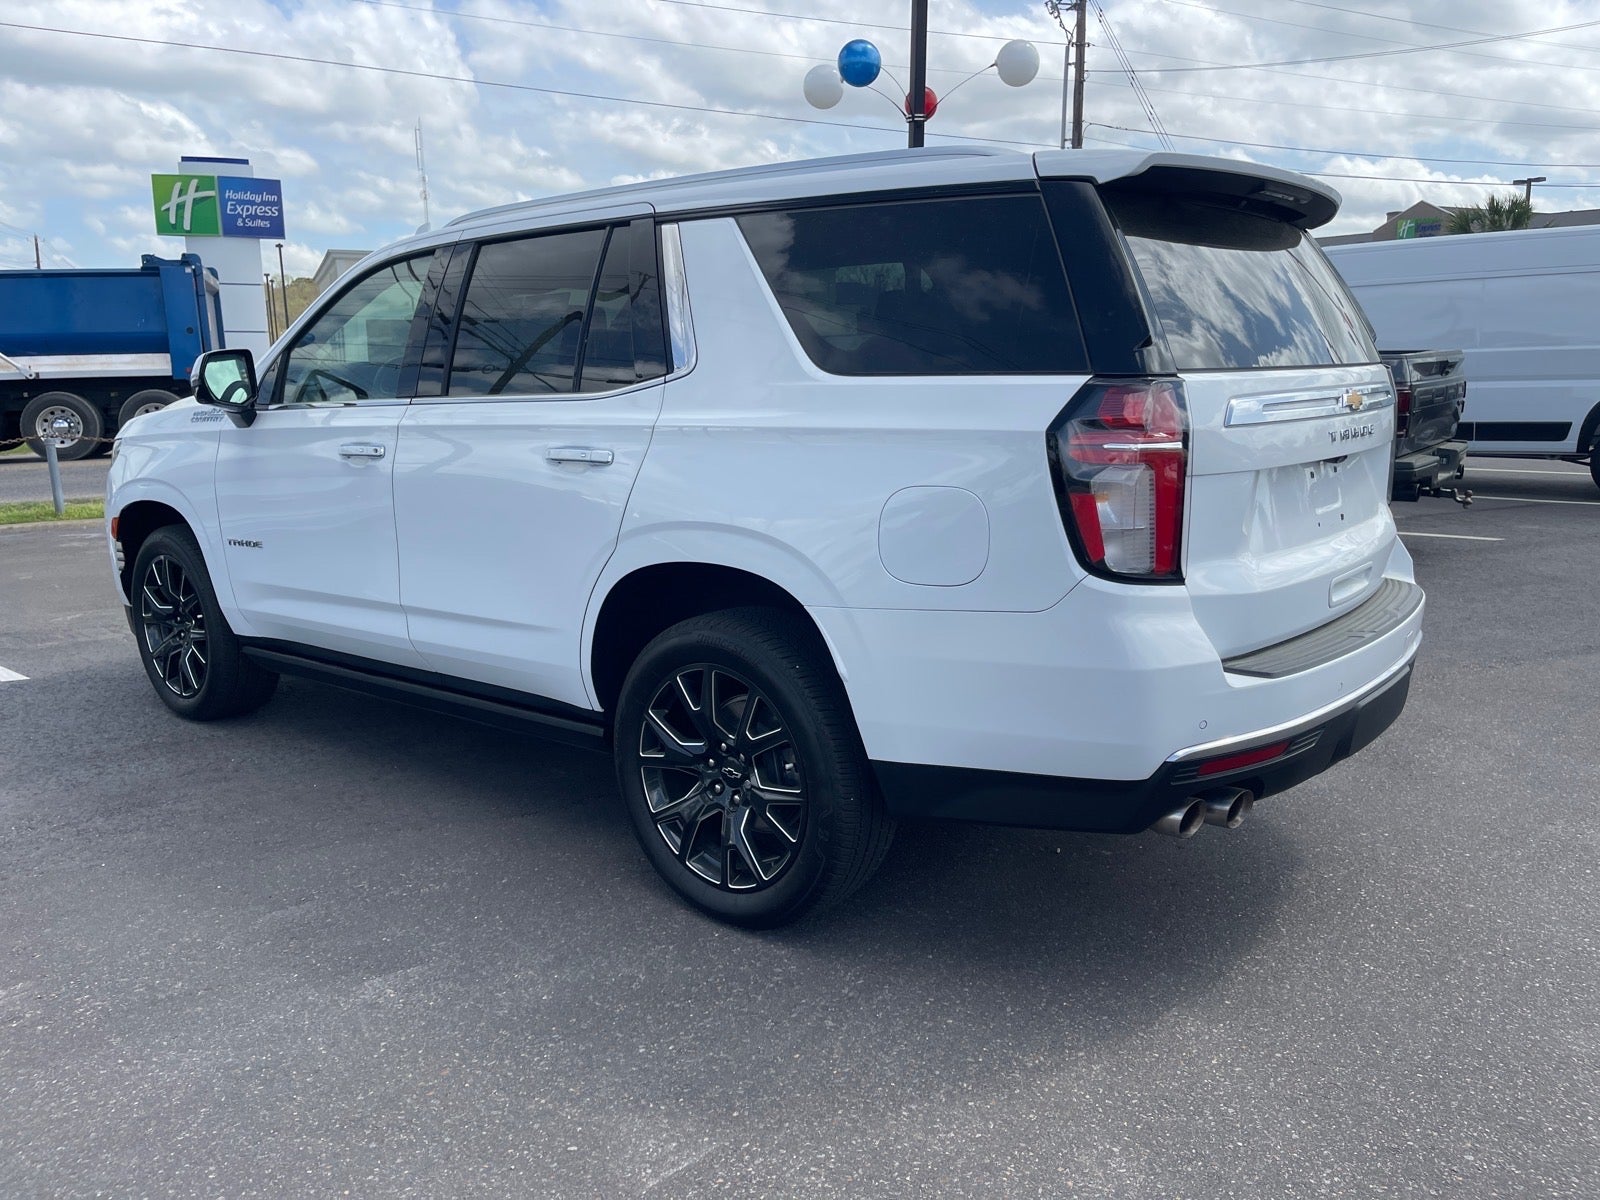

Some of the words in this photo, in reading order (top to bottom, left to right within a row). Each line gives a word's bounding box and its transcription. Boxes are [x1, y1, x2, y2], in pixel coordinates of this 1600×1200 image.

[225, 189, 262, 203] Holiday
[263, 192, 278, 202] Inn
[226, 201, 278, 218] Express
[236, 217, 244, 227] &
[244, 218, 271, 228] Suites
[227, 538, 263, 548] TAHOE
